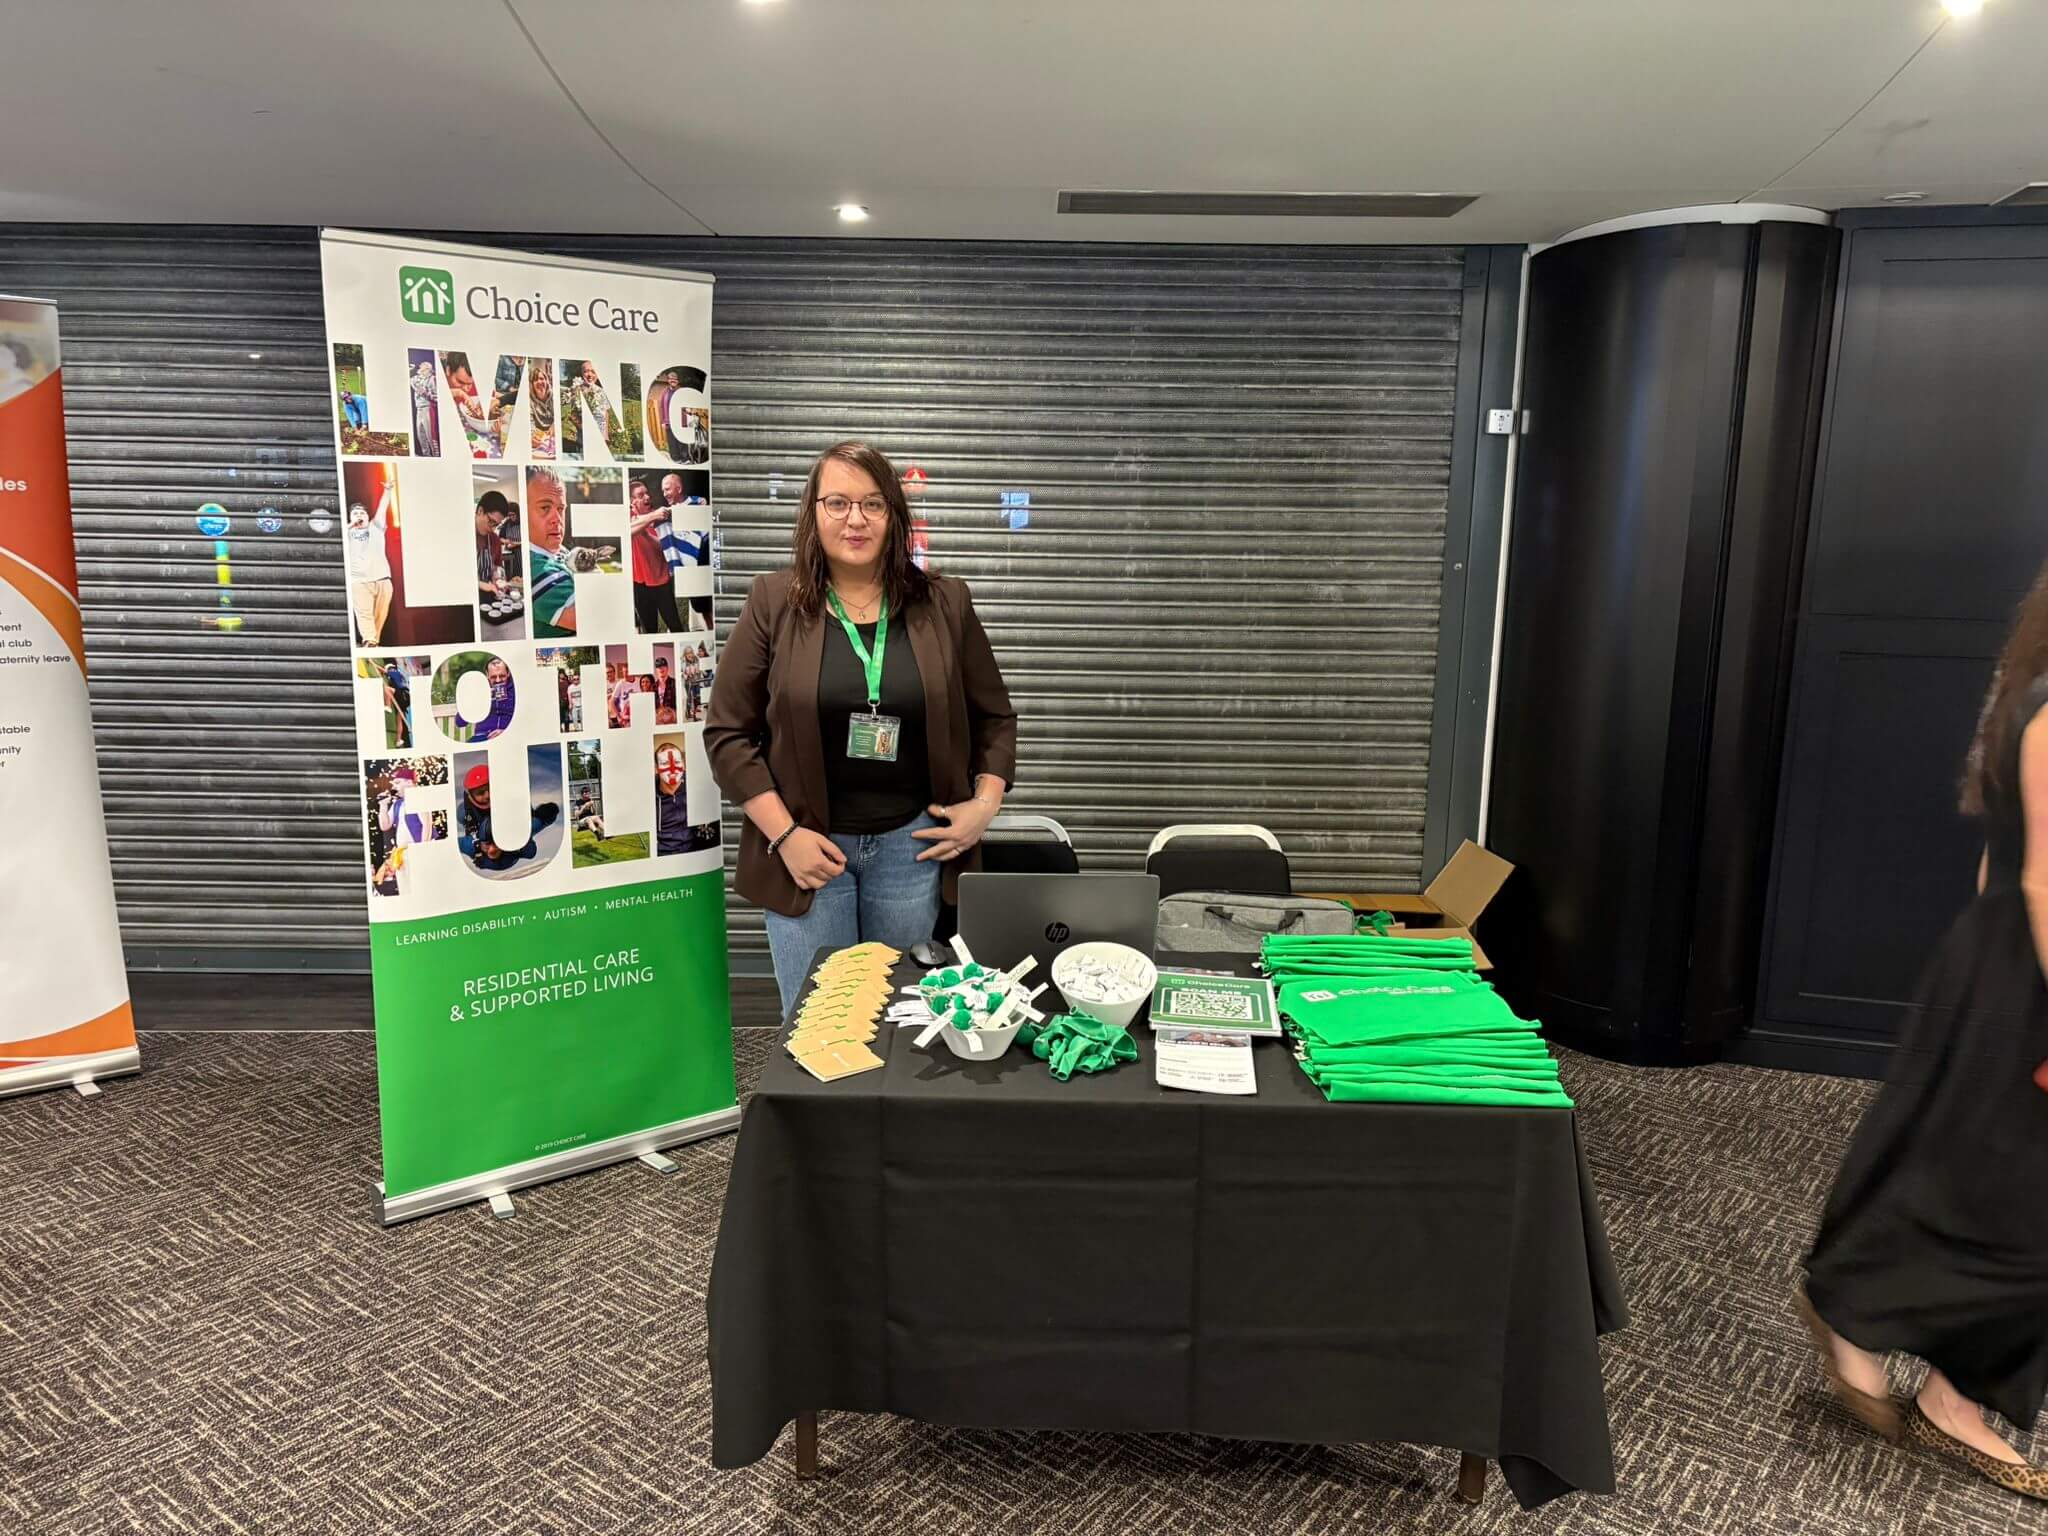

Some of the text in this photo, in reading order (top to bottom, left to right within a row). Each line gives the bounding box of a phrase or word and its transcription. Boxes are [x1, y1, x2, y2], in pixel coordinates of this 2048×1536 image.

[466, 286, 659, 333] Choice Care
[332, 342, 710, 465] LIVING
[342, 461, 714, 647] LIFE
[8, 639, 32, 648] club
[43, 654, 71, 663] leave
[357, 639, 715, 749] TO THE
[363, 732, 721, 897] FULL
[395, 888, 693, 946] LEARNING DISABILITY AUTISM MENTAL HEALTH
[1048, 922, 1068, 944] hp
[450, 966, 654, 1022] & SUPPORTED LIVING
[463, 948, 640, 997] RESIDENTIAL CARE
